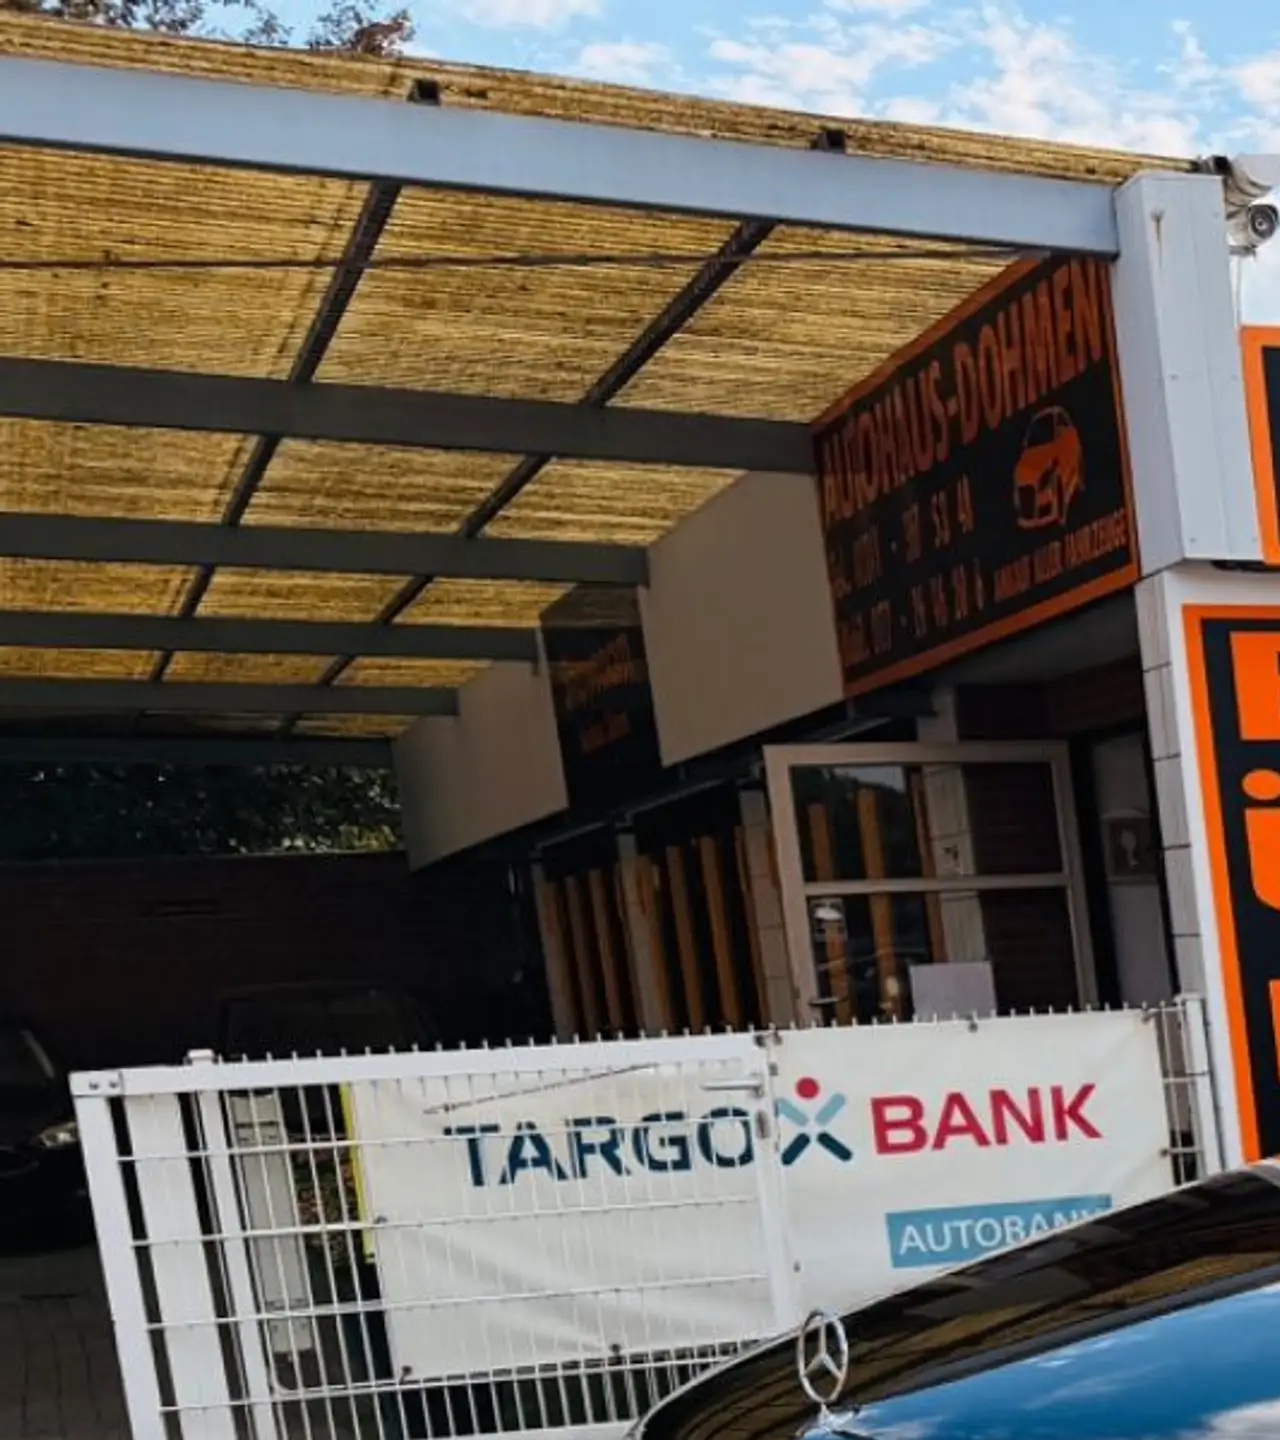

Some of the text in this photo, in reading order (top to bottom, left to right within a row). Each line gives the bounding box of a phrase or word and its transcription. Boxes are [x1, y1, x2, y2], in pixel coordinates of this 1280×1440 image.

[822, 257, 1103, 525] AUTOHAUS-DOHMEN
[444, 1082, 1105, 1188] TARGO BANK
